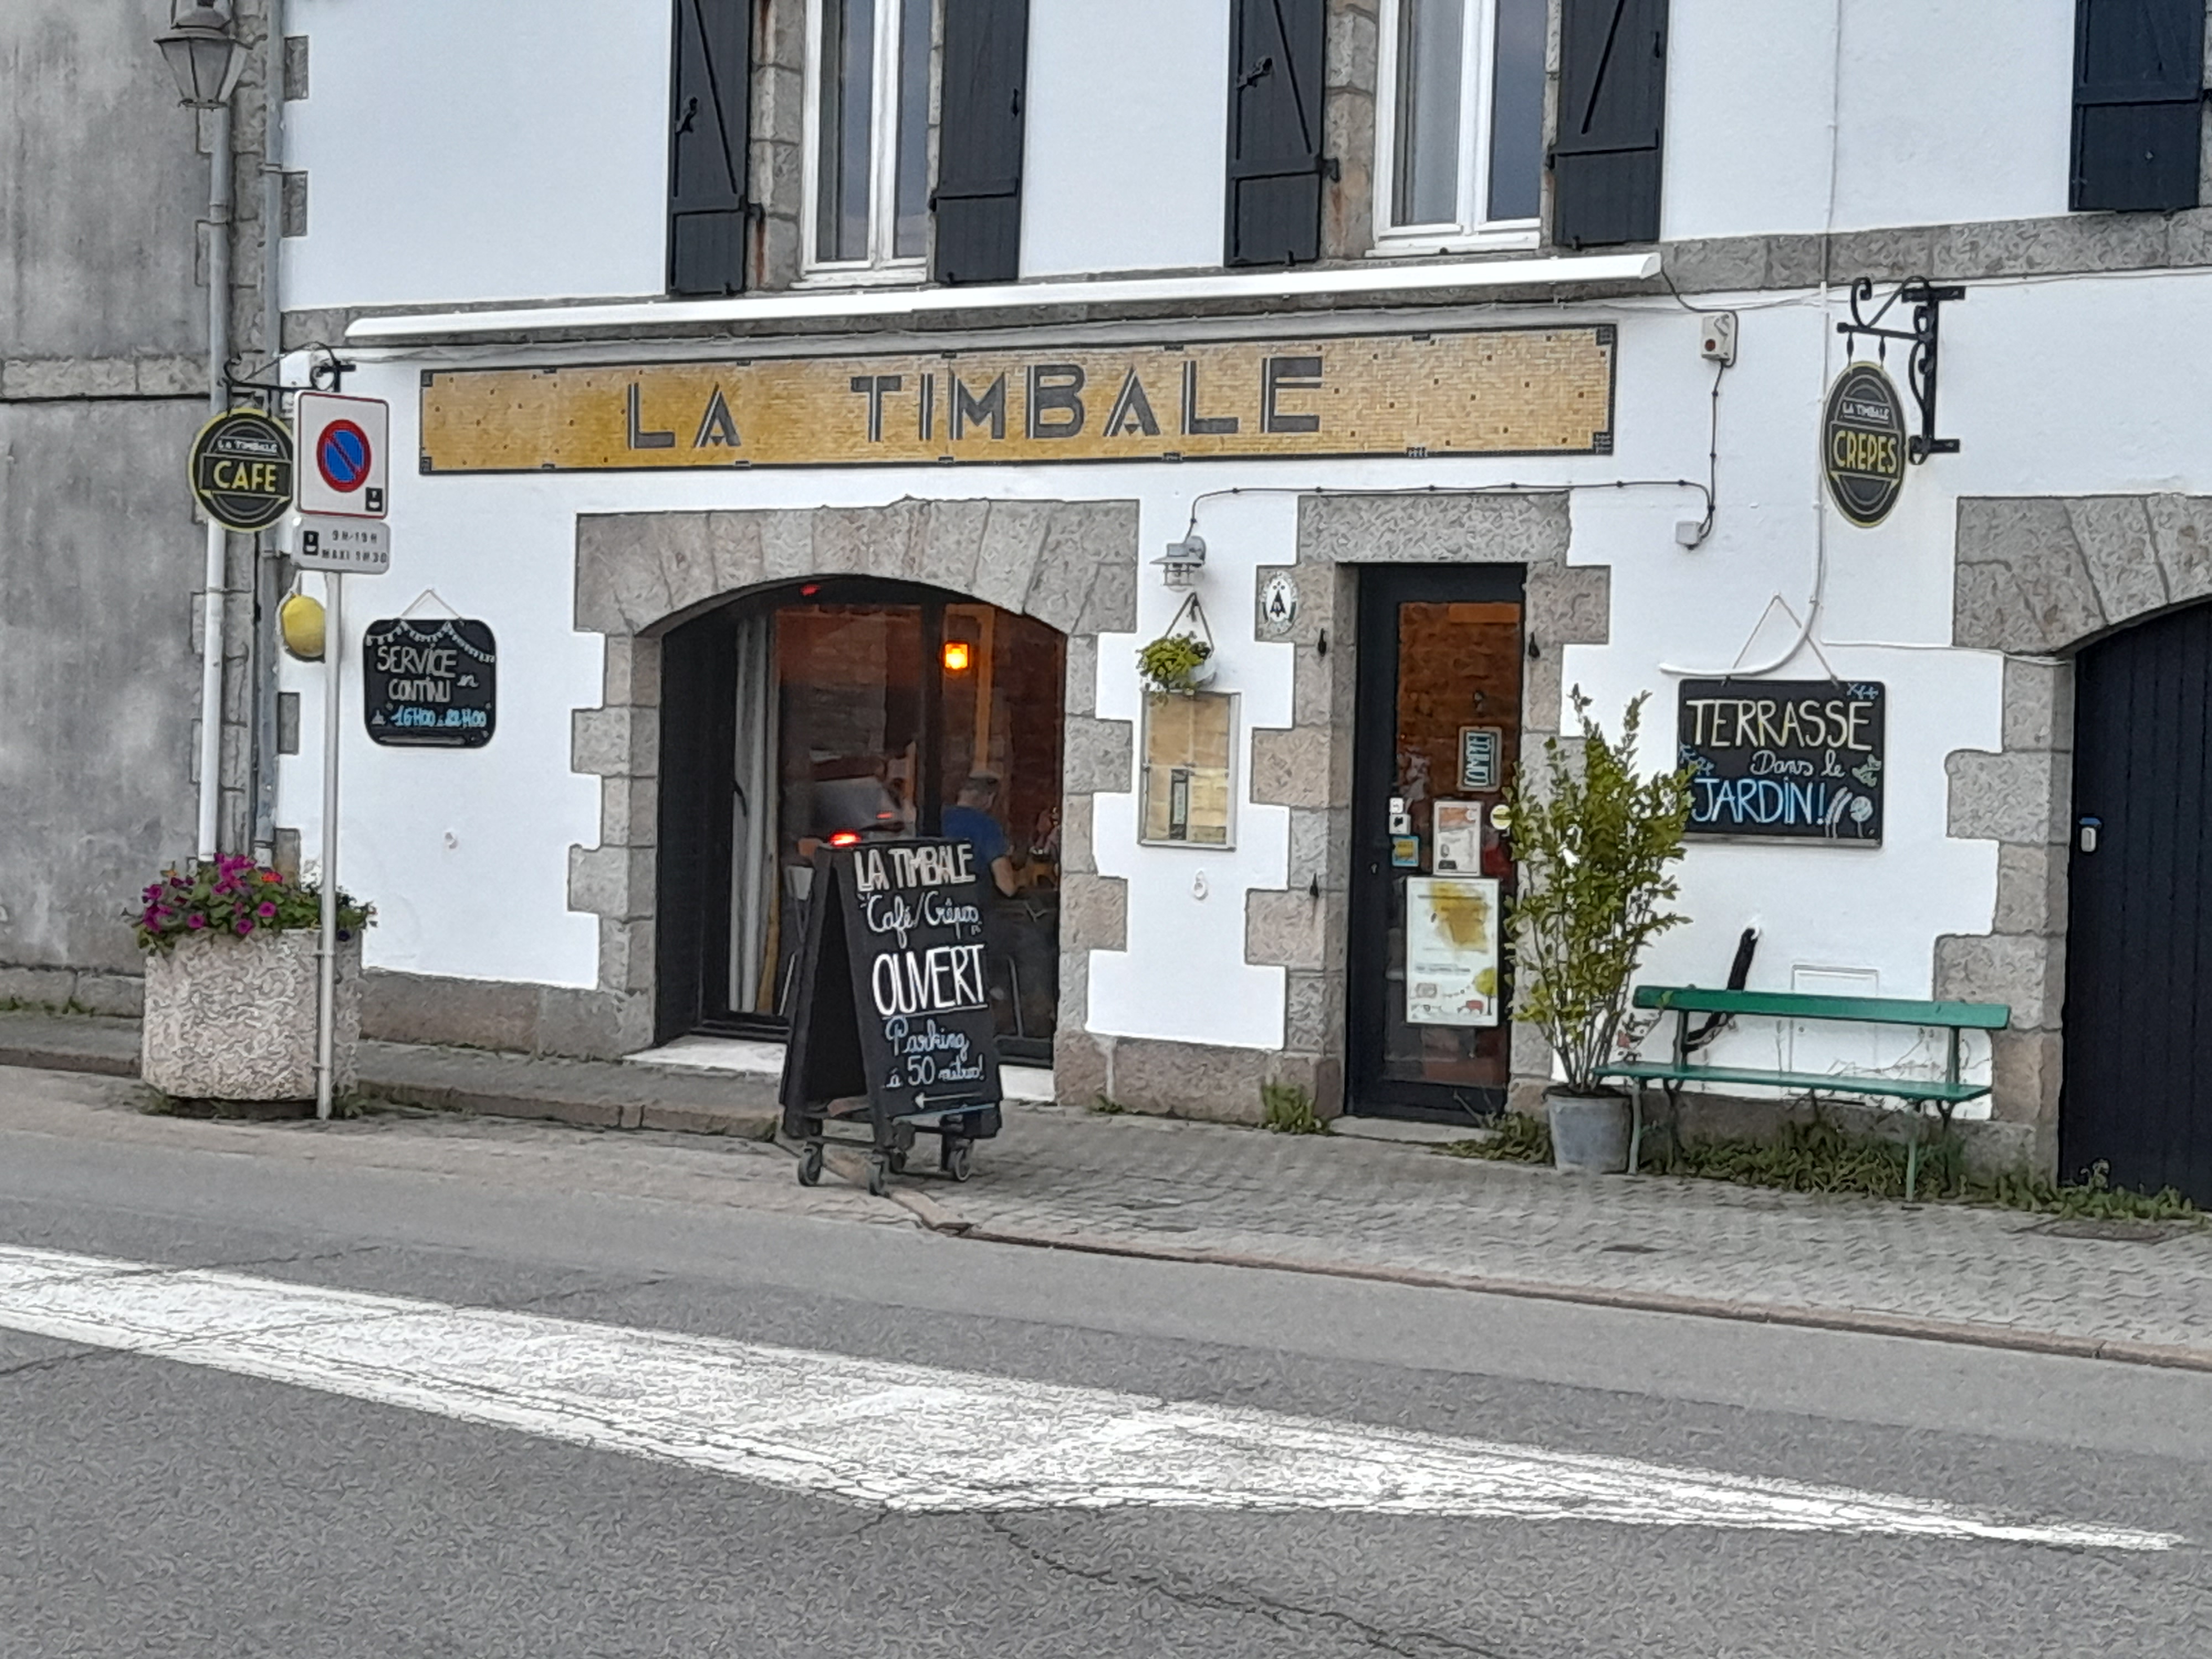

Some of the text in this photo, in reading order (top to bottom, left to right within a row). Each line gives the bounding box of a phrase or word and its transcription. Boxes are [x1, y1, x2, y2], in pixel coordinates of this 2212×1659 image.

[627, 356, 1322, 450] LA TIMBALE
[1833, 430, 1897, 474] CREPES
[213, 460, 276, 492] CAFE
[377, 644, 457, 678] SERVICE
[1686, 698, 1873, 751] TERRASSE
[1750, 749, 1845, 778] Dans le
[854, 844, 976, 892] LA TIMBALE
[872, 944, 985, 1016] OUVERT
[885, 1016, 970, 1062] Parking
[907, 1055, 936, 1086] 50
